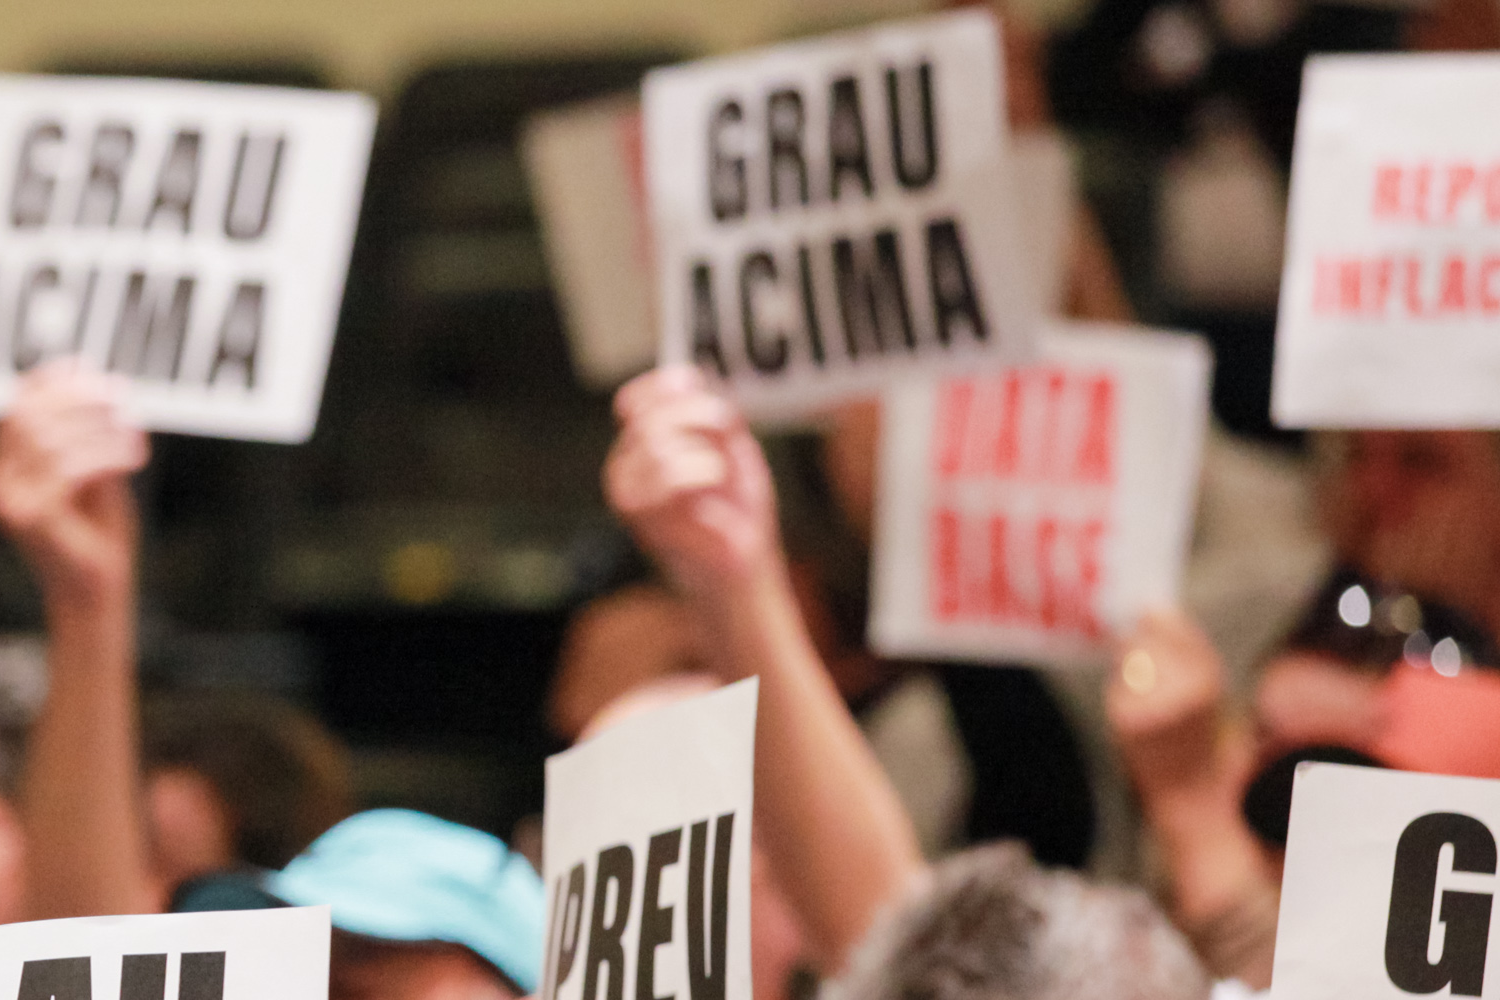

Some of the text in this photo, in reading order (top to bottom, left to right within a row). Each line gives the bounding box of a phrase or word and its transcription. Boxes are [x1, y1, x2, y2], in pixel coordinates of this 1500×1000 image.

[7, 120, 288, 241] GRAU
[705, 55, 942, 224] GRAU
[688, 216, 992, 382] ACIMA
